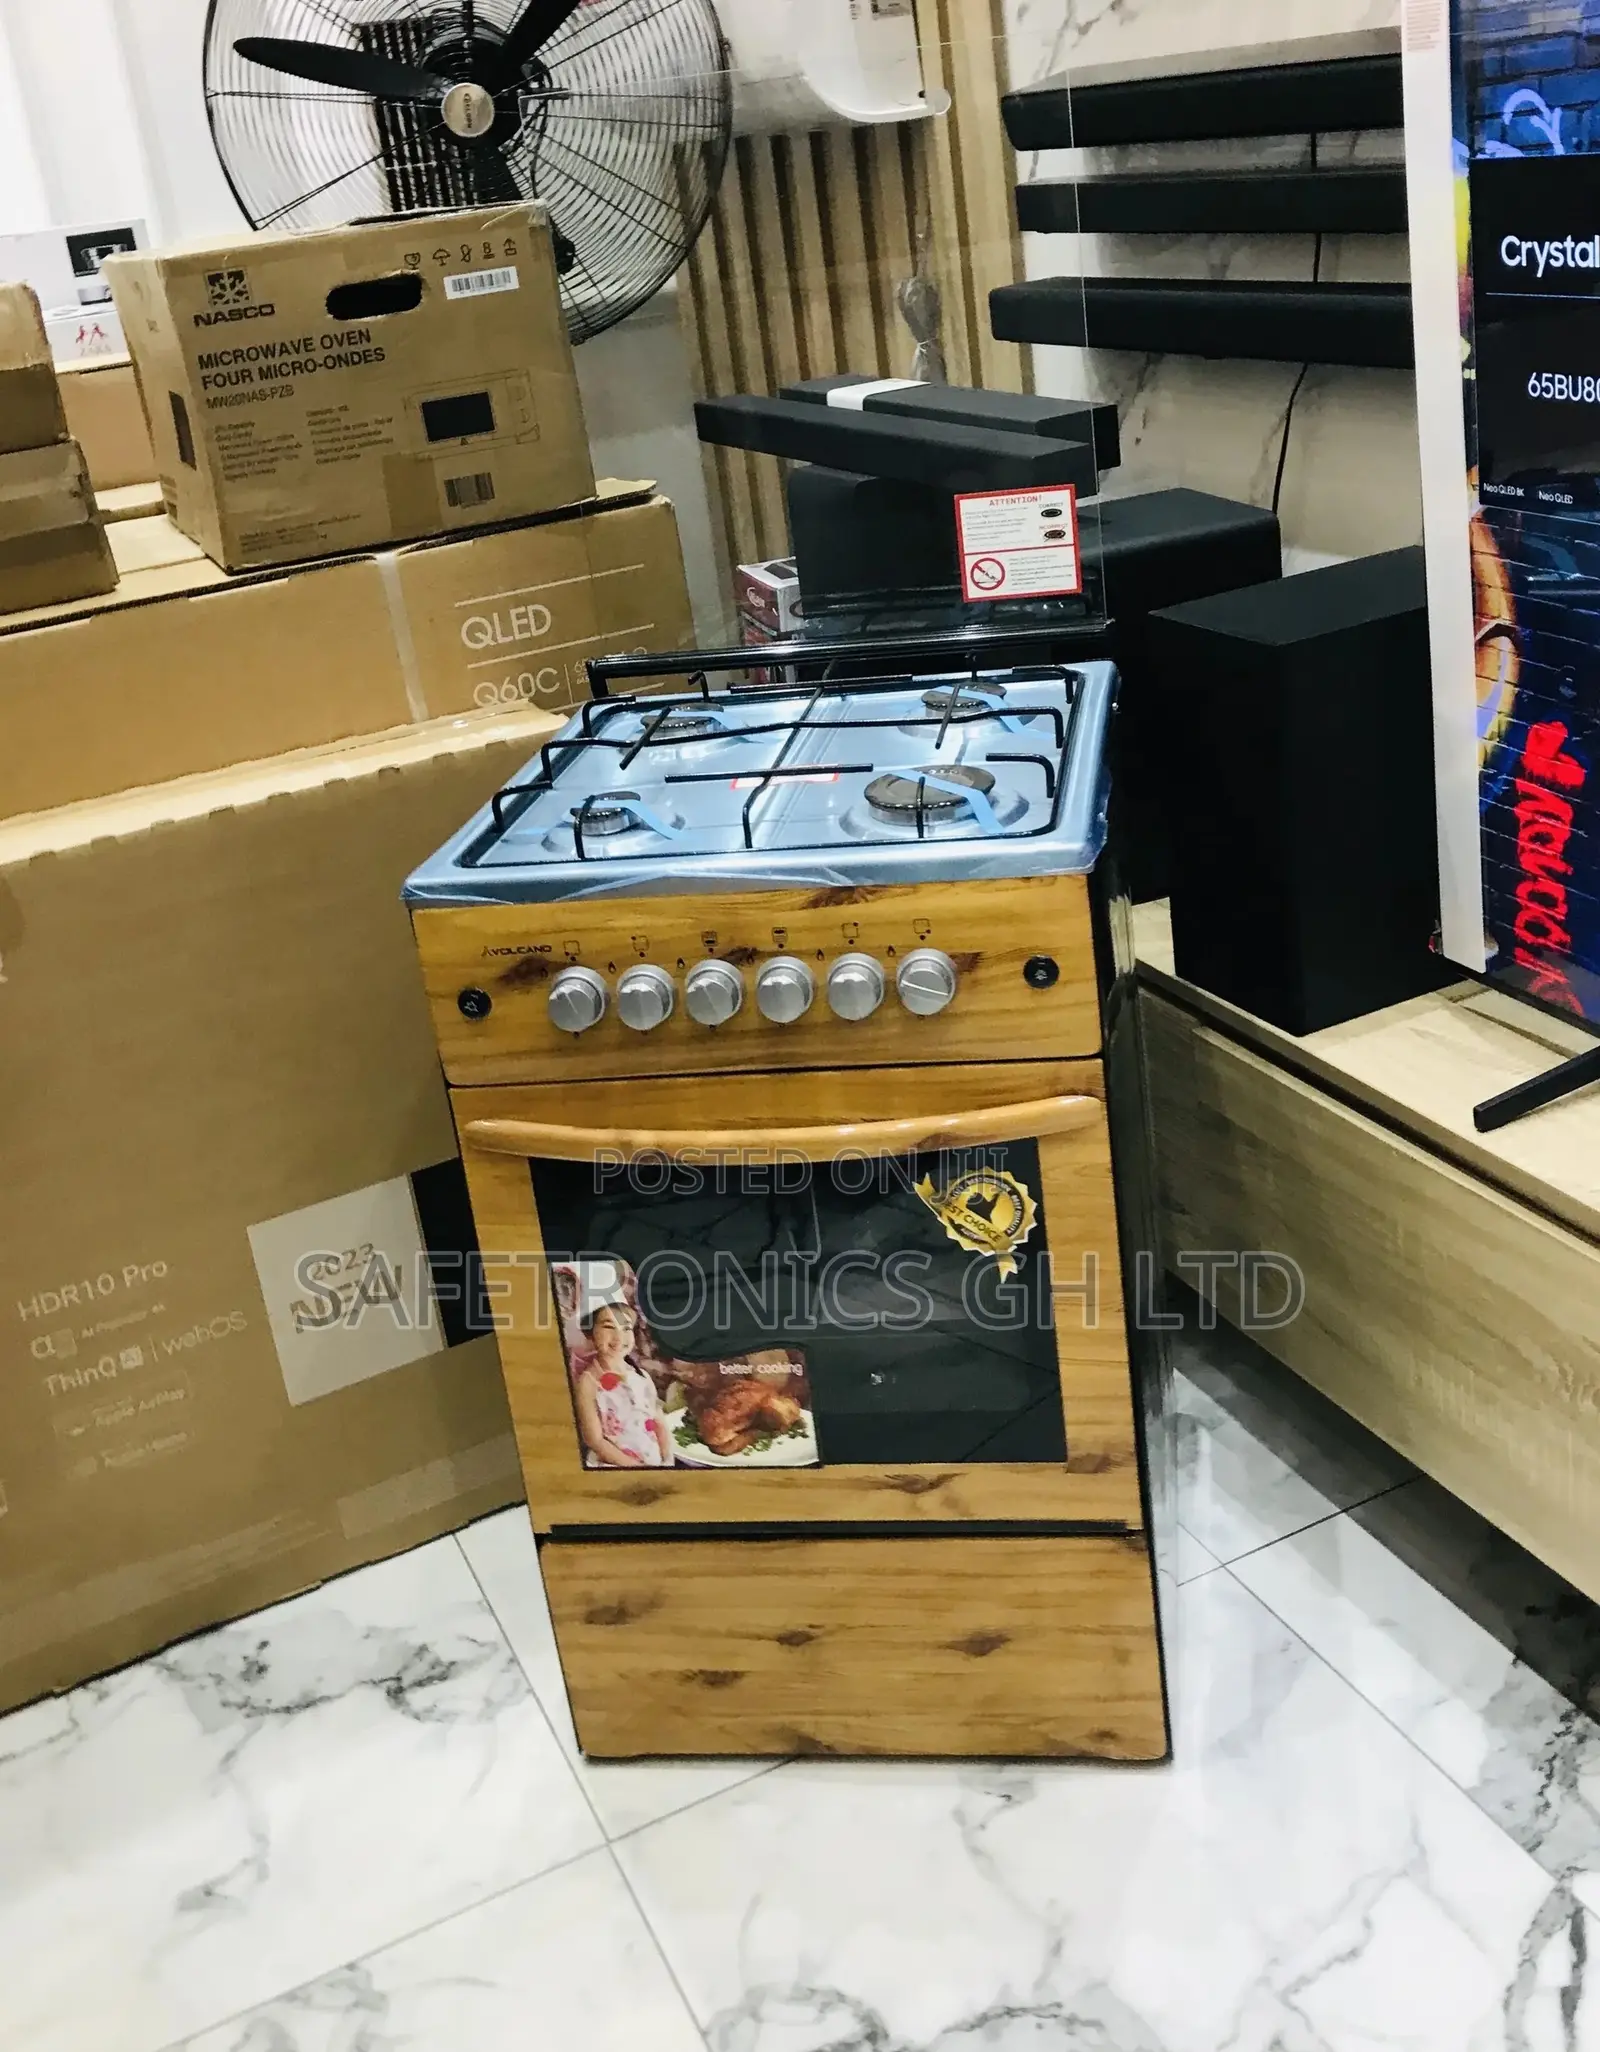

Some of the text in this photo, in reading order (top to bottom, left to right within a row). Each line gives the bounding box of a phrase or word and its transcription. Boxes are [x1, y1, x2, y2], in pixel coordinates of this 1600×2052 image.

[1501, 235, 1600, 278] Crystal
[193, 303, 276, 328] NASCO
[198, 328, 372, 370] MICROWAVE OVEN
[201, 347, 386, 391] FOUR MICRO-ONDES
[989, 494, 1043, 507] ATTENTION!
[1483, 482, 1526, 497] Neo QLED 8K
[1538, 490, 1574, 504] Neo QLED
[460, 604, 552, 650] QLED
[473, 667, 560, 707] Q60C
[964, 1214, 1001, 1242] CHOICE
[309, 1242, 378, 1282] 2023
[17, 1261, 168, 1321] HDR10 Pro
[289, 1265, 404, 1333] NEW
[162, 1310, 248, 1356] webOS
[46, 1356, 118, 1396] ThinQ
[719, 1361, 804, 1376] better cooking
